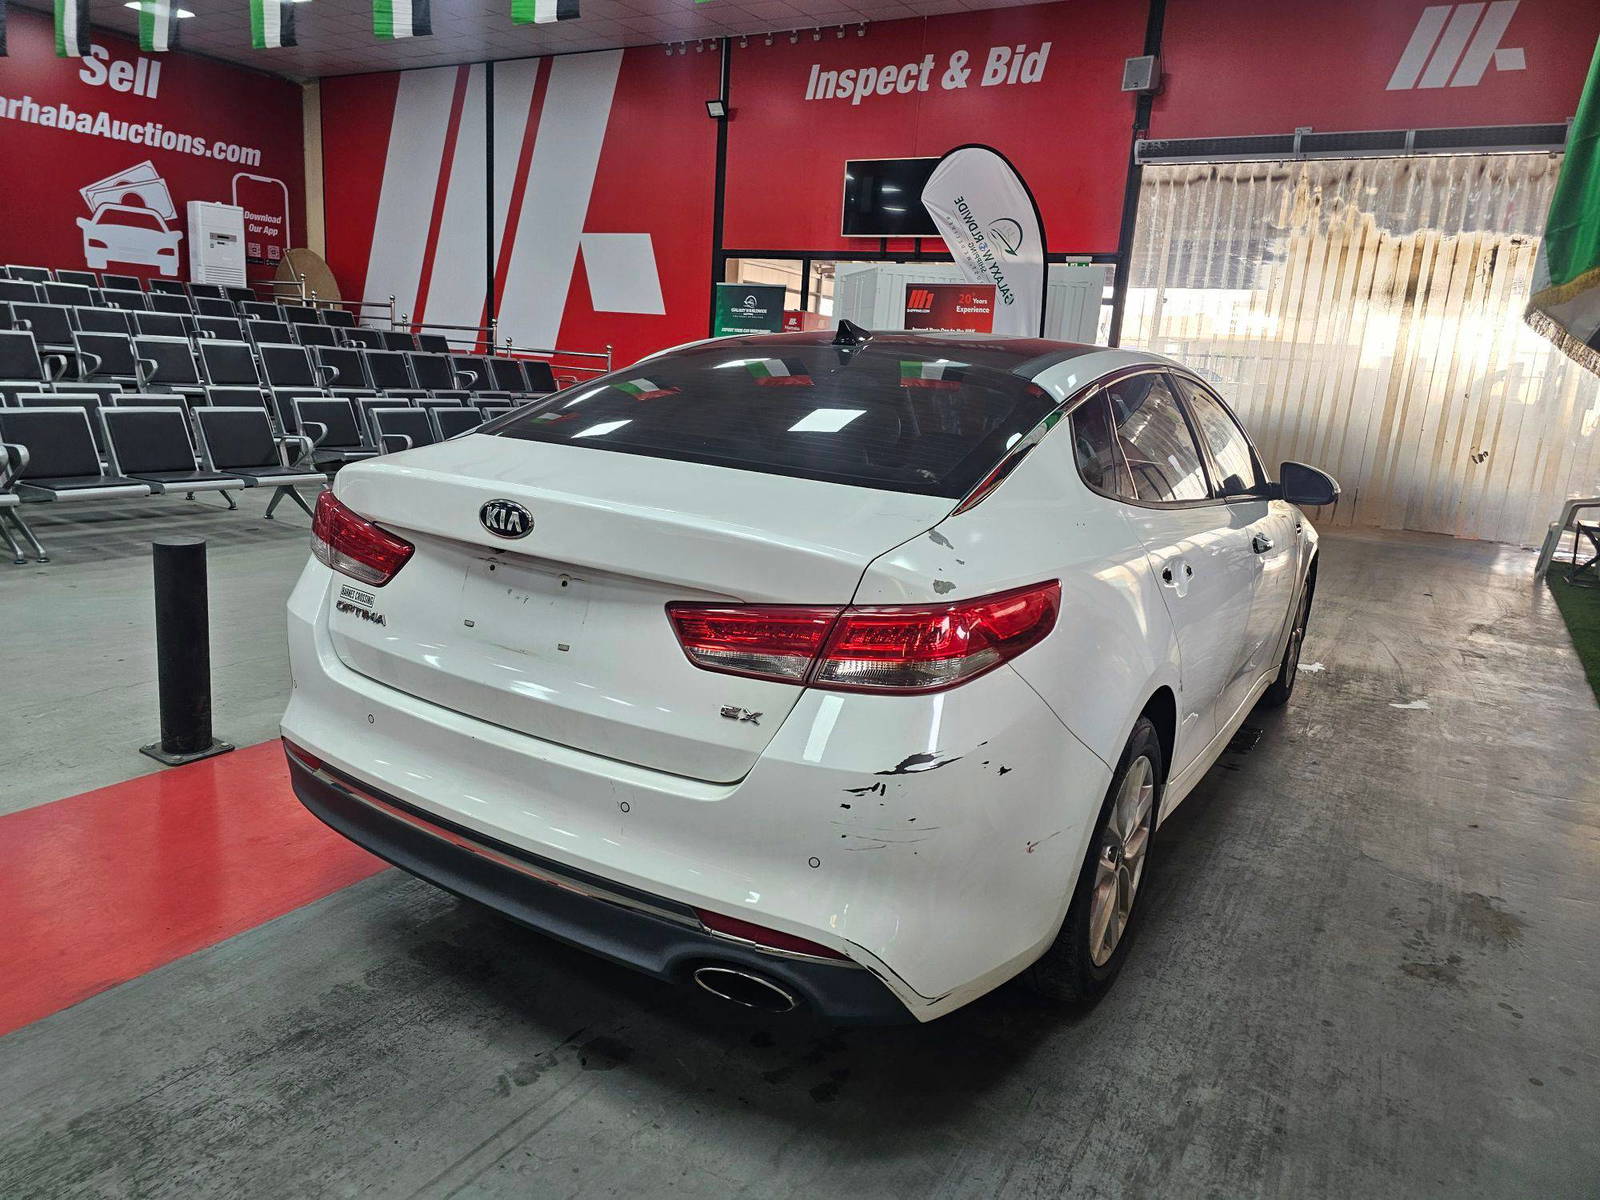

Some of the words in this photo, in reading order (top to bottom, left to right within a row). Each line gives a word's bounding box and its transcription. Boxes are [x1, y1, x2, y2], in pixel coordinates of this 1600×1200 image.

[79, 44, 161, 99] Sell
[805, 54, 935, 105] Inspect
[941, 50, 971, 90] &
[981, 42, 1052, 87] Bid
[244, 210, 282, 224] Download
[249, 223, 263, 233] Our
[263, 226, 278, 237] App
[956, 306, 990, 314] Experience
[486, 506, 522, 533] KIA
[354, 590, 375, 606] CROSSING
[336, 600, 387, 627] OPTIMA
[720, 704, 763, 726] EX
